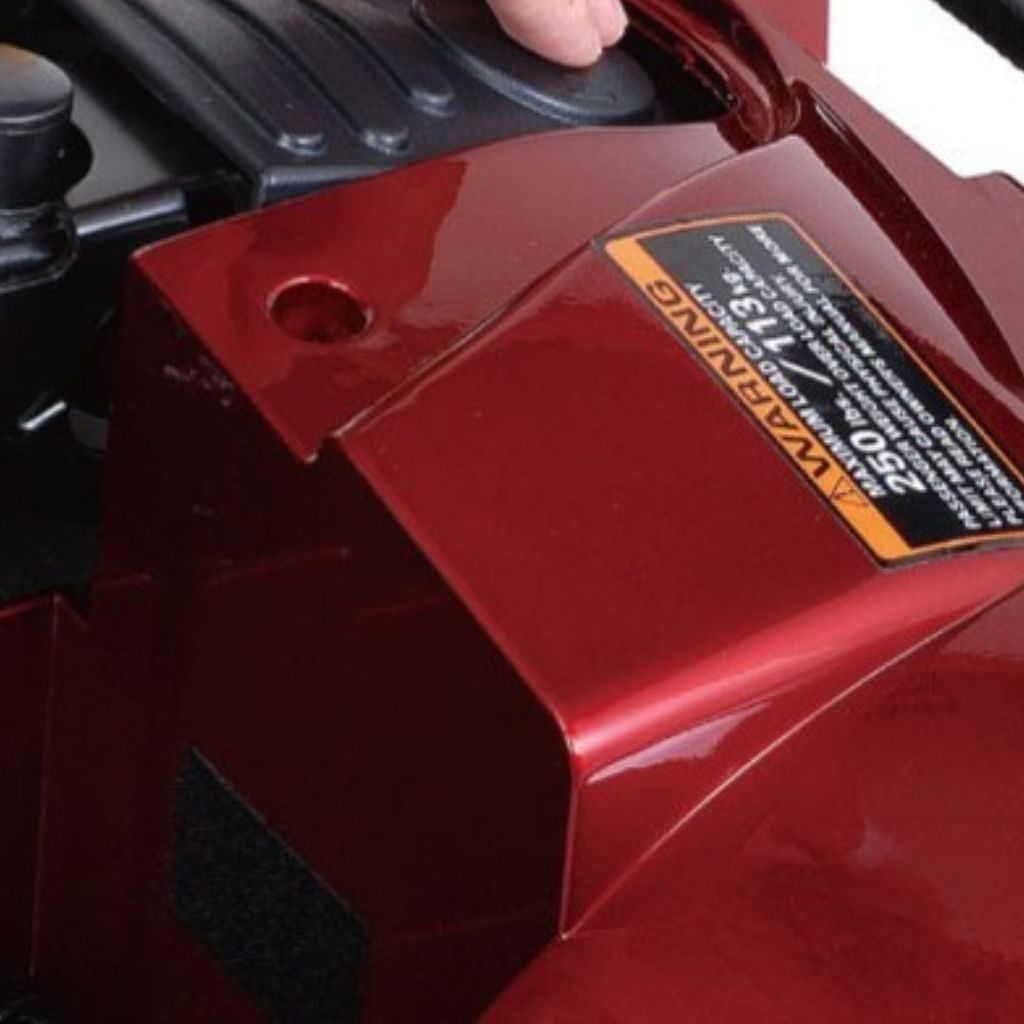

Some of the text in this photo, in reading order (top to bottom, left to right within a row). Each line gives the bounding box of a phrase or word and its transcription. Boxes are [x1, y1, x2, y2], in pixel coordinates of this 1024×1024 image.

[749, 226, 792, 264] MORE
[787, 265, 818, 293] FOR
[729, 297, 794, 352] 113
[816, 294, 876, 356] MANUAL
[647, 281, 830, 479] WARNING
[709, 236, 981, 529] PASSENGER WEIGHT OVER LOAD CAPACITY
[822, 327, 888, 396] PHYSICAL
[686, 284, 886, 497] MAXIMUM LOAD CAPACITY
[882, 398, 932, 447] CAUSE
[931, 427, 972, 466] READ
[850, 430, 926, 493] 250
[927, 451, 964, 483] MAY
[957, 486, 1002, 527] LIMIT
[966, 469, 1022, 524] PLEASE
